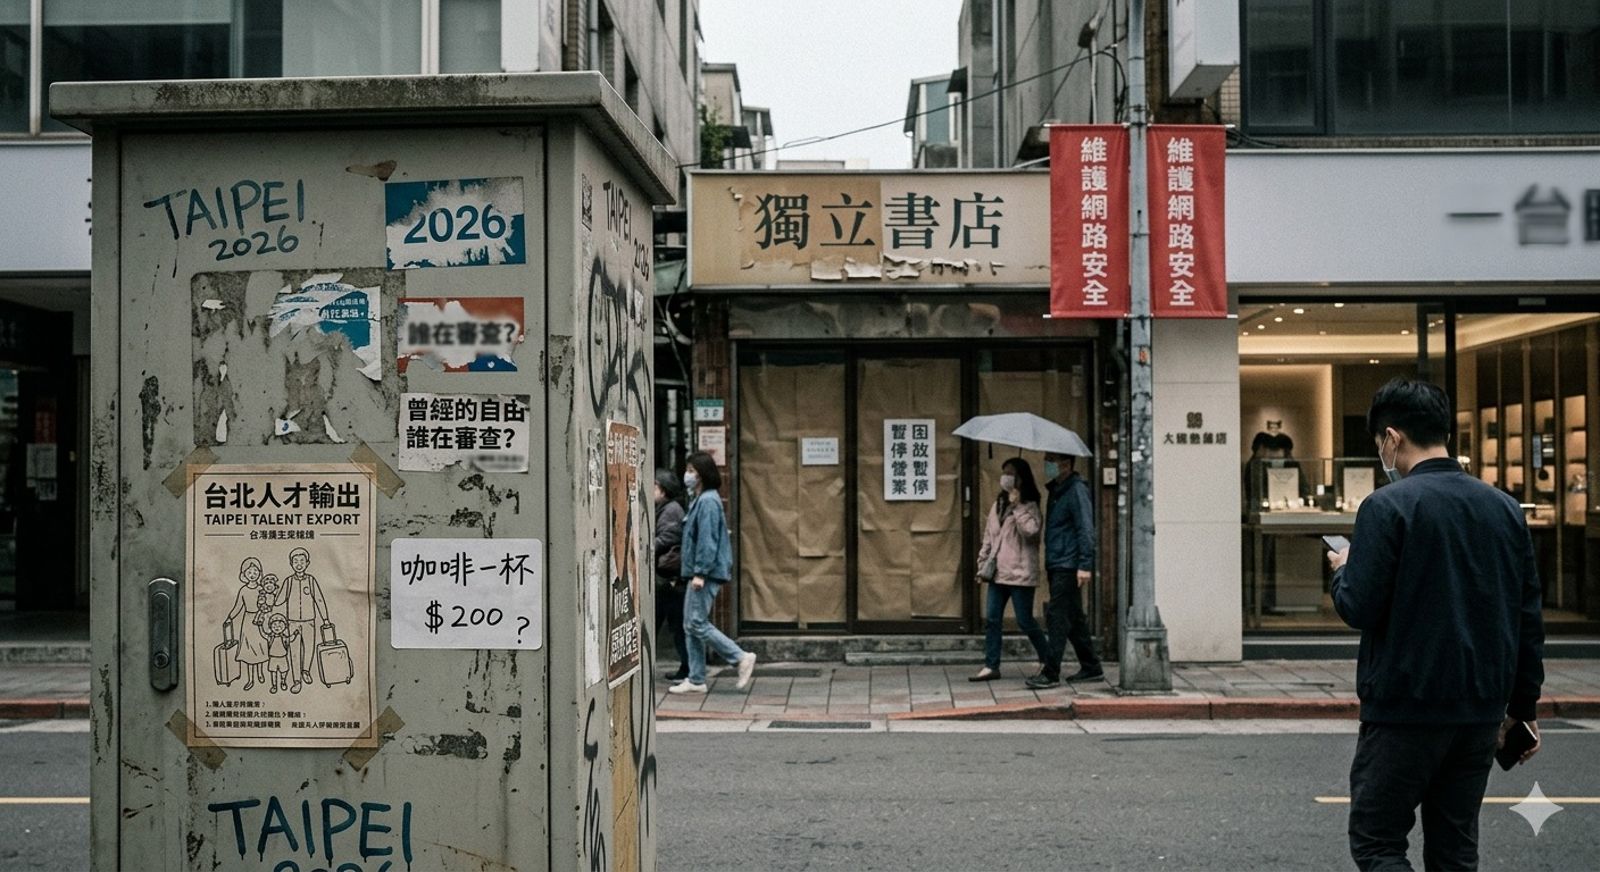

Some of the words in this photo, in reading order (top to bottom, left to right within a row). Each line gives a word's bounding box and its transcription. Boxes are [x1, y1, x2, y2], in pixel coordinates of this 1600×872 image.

[144, 179, 306, 240] TAIPEI
[404, 205, 507, 244] 2026
[753, 191, 1004, 250] 獨立書店
[1081, 136, 1109, 307] 維護網路安全
[1167, 136, 1196, 307] 維護網路安全
[208, 225, 300, 261] 2026
[408, 397, 525, 422] 曾經的自由
[406, 425, 516, 450] 誰在審查?
[204, 481, 360, 509] 台北人才輸出
[204, 513, 247, 526] TAIPEI
[251, 513, 302, 525] TALENT
[306, 513, 361, 525] EXPORT
[401, 551, 535, 587] 咖啡一杯
[207, 795, 412, 863] TAIPEI
